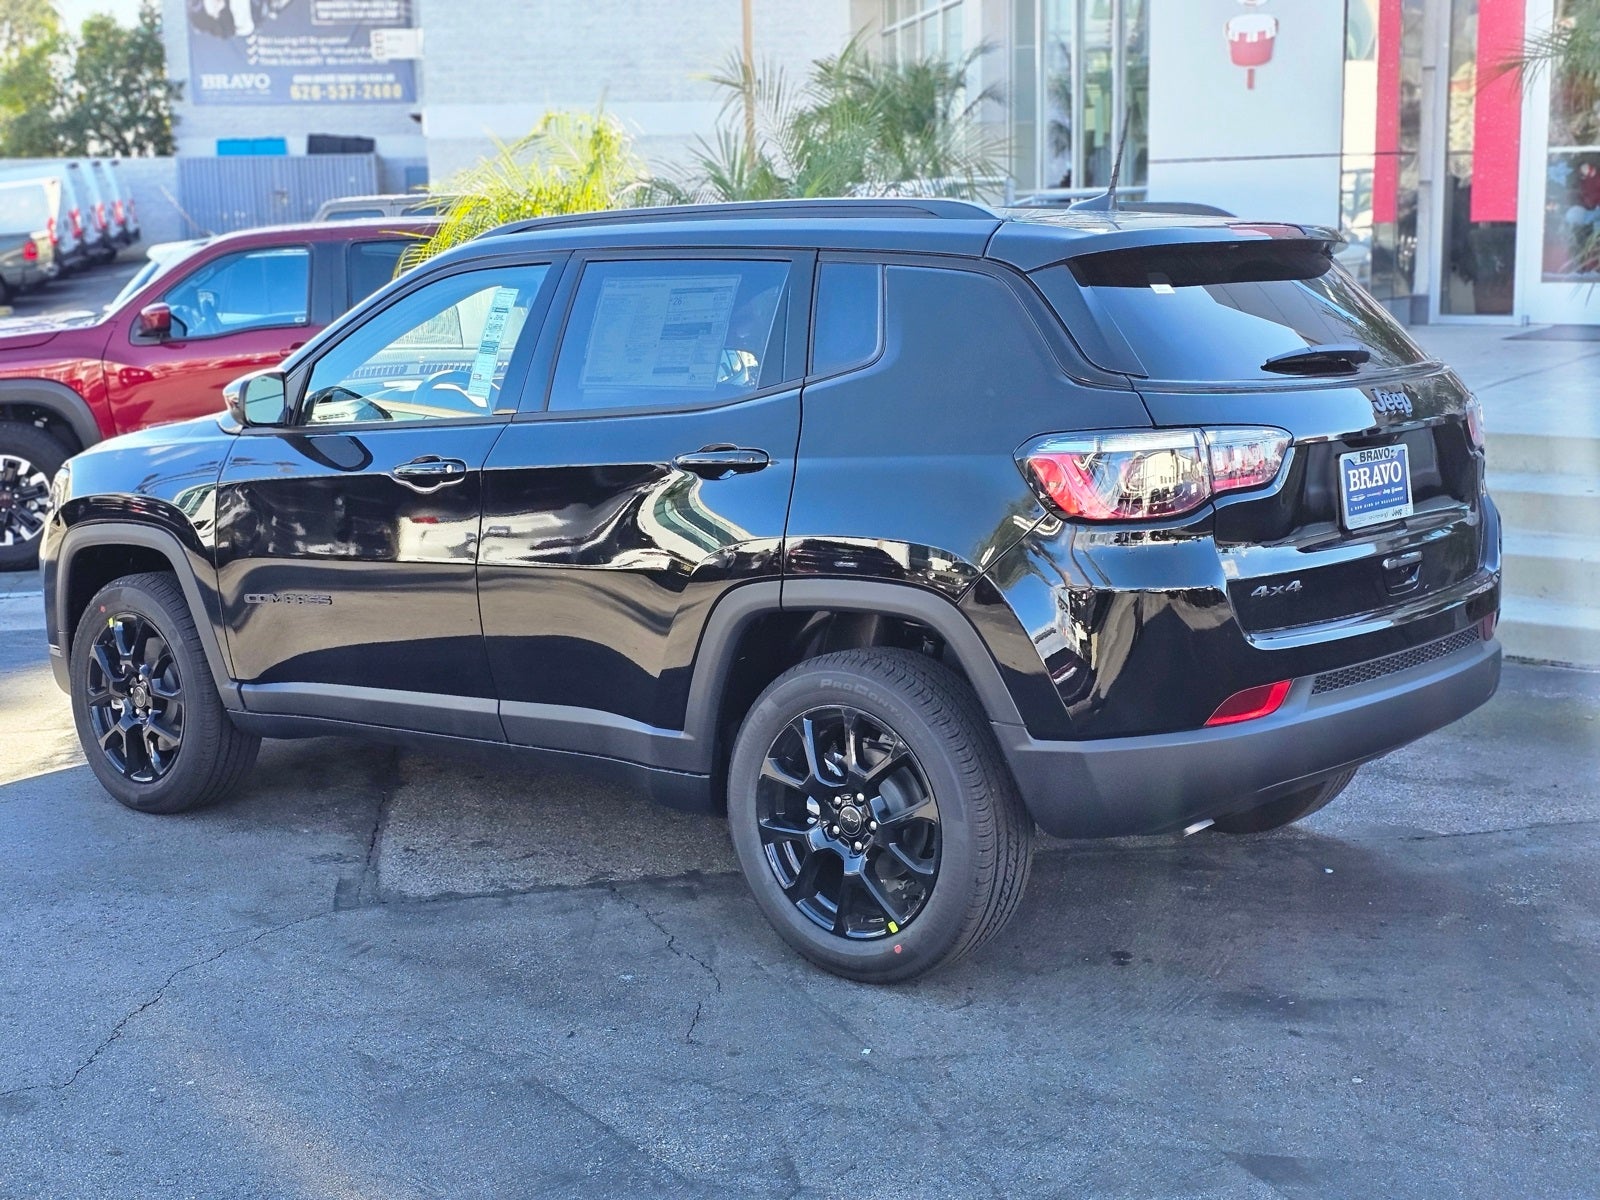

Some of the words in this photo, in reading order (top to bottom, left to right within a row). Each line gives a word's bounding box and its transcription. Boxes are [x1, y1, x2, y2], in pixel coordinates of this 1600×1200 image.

[200, 73, 270, 89] BRAVO
[1371, 387, 1412, 417] Jeep
[1359, 447, 1390, 463] BRAVO
[1348, 461, 1402, 493] BRAVO
[1251, 580, 1303, 597] 4x4
[243, 593, 333, 605] COMPASS
